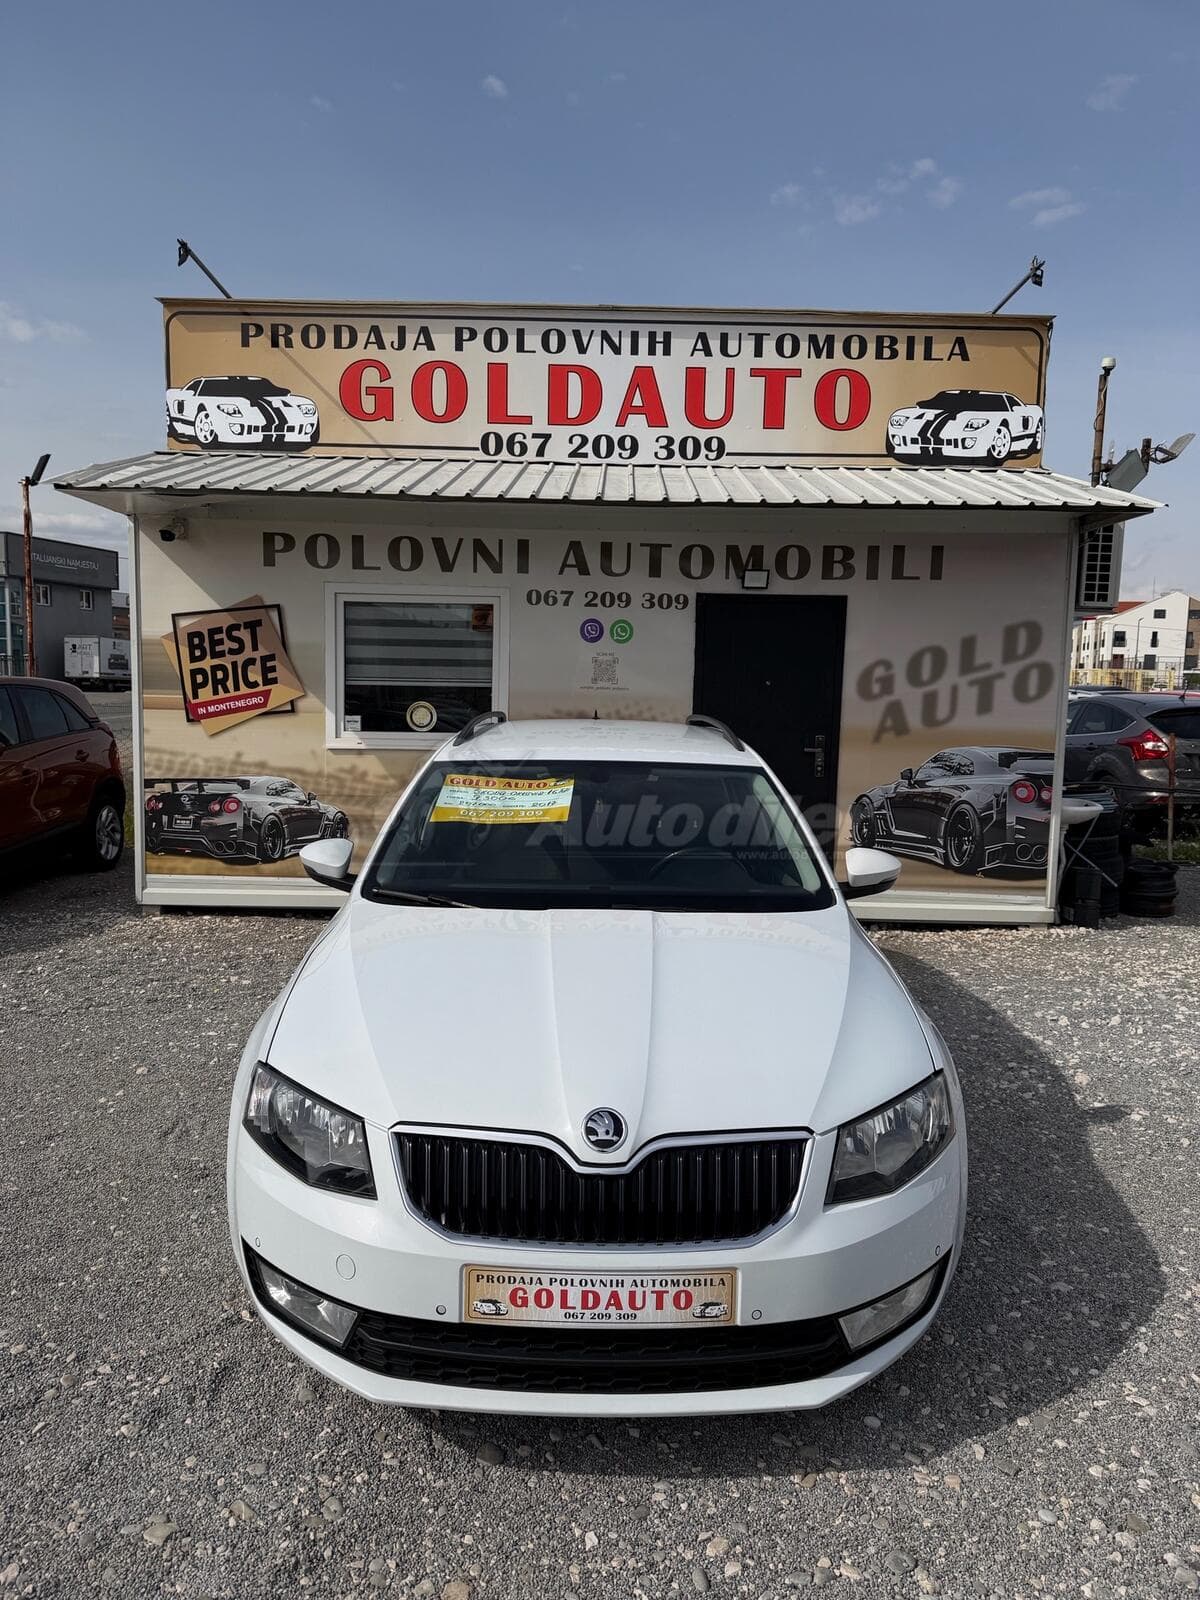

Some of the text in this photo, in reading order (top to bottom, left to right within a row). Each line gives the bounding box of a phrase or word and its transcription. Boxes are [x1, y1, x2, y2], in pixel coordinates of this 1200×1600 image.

[240, 323, 970, 362] PRODAJA POLOVNIH AUTOMOBILA
[339, 358, 872, 431] GOLDAUTO
[480, 431, 727, 461] 067 209 309
[262, 531, 945, 581] POLOVNI AUTOMOBILI
[526, 589, 689, 610] 067 209 309
[187, 619, 263, 664] BEST
[855, 619, 1043, 702] GOLD
[189, 653, 279, 700] PRICE
[197, 696, 265, 715] IN MONTENEGRO
[872, 660, 1056, 744] AUTO
[449, 777, 548, 789] GOLD AUTO
[460, 809, 544, 817] 067 209 309
[475, 1273, 727, 1289] PRODAJA POLOVNIH AUTOMOBILA
[508, 1286, 694, 1311] GOLDAUTO
[564, 1311, 638, 1321] 067 209 309
